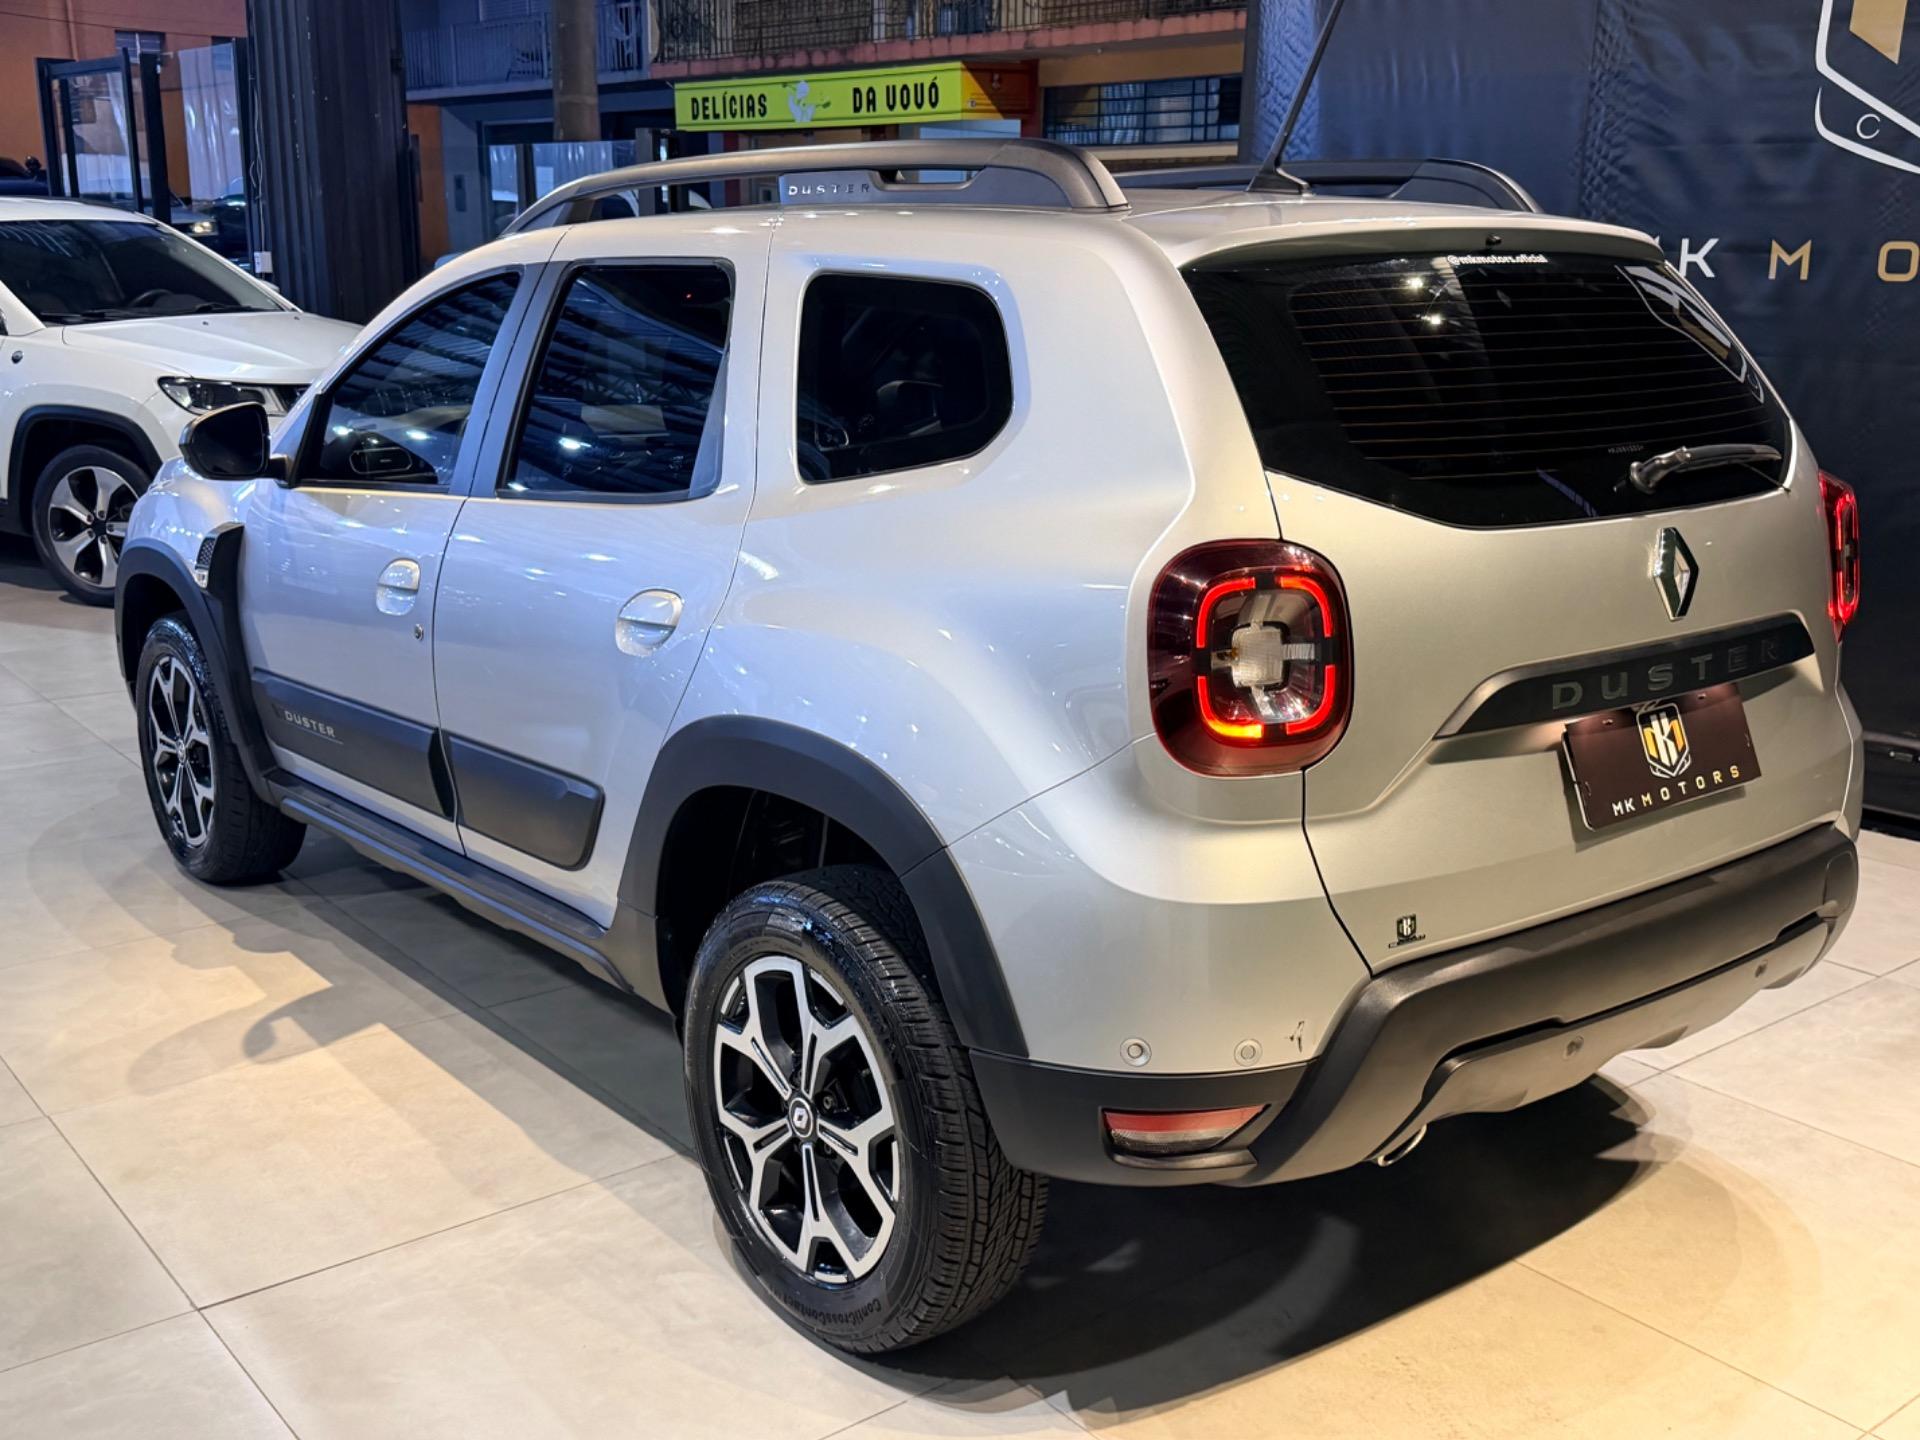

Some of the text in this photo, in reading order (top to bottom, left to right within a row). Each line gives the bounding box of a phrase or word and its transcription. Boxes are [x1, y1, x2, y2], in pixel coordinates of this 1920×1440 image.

[691, 91, 767, 120] DELÍCIAS
[852, 86, 877, 113] DA
[788, 183, 870, 196] DUSTER
[1552, 639, 1780, 710] DUSTER
[284, 711, 336, 738] DUSTER
[1612, 765, 1740, 816] MK MOTORS
